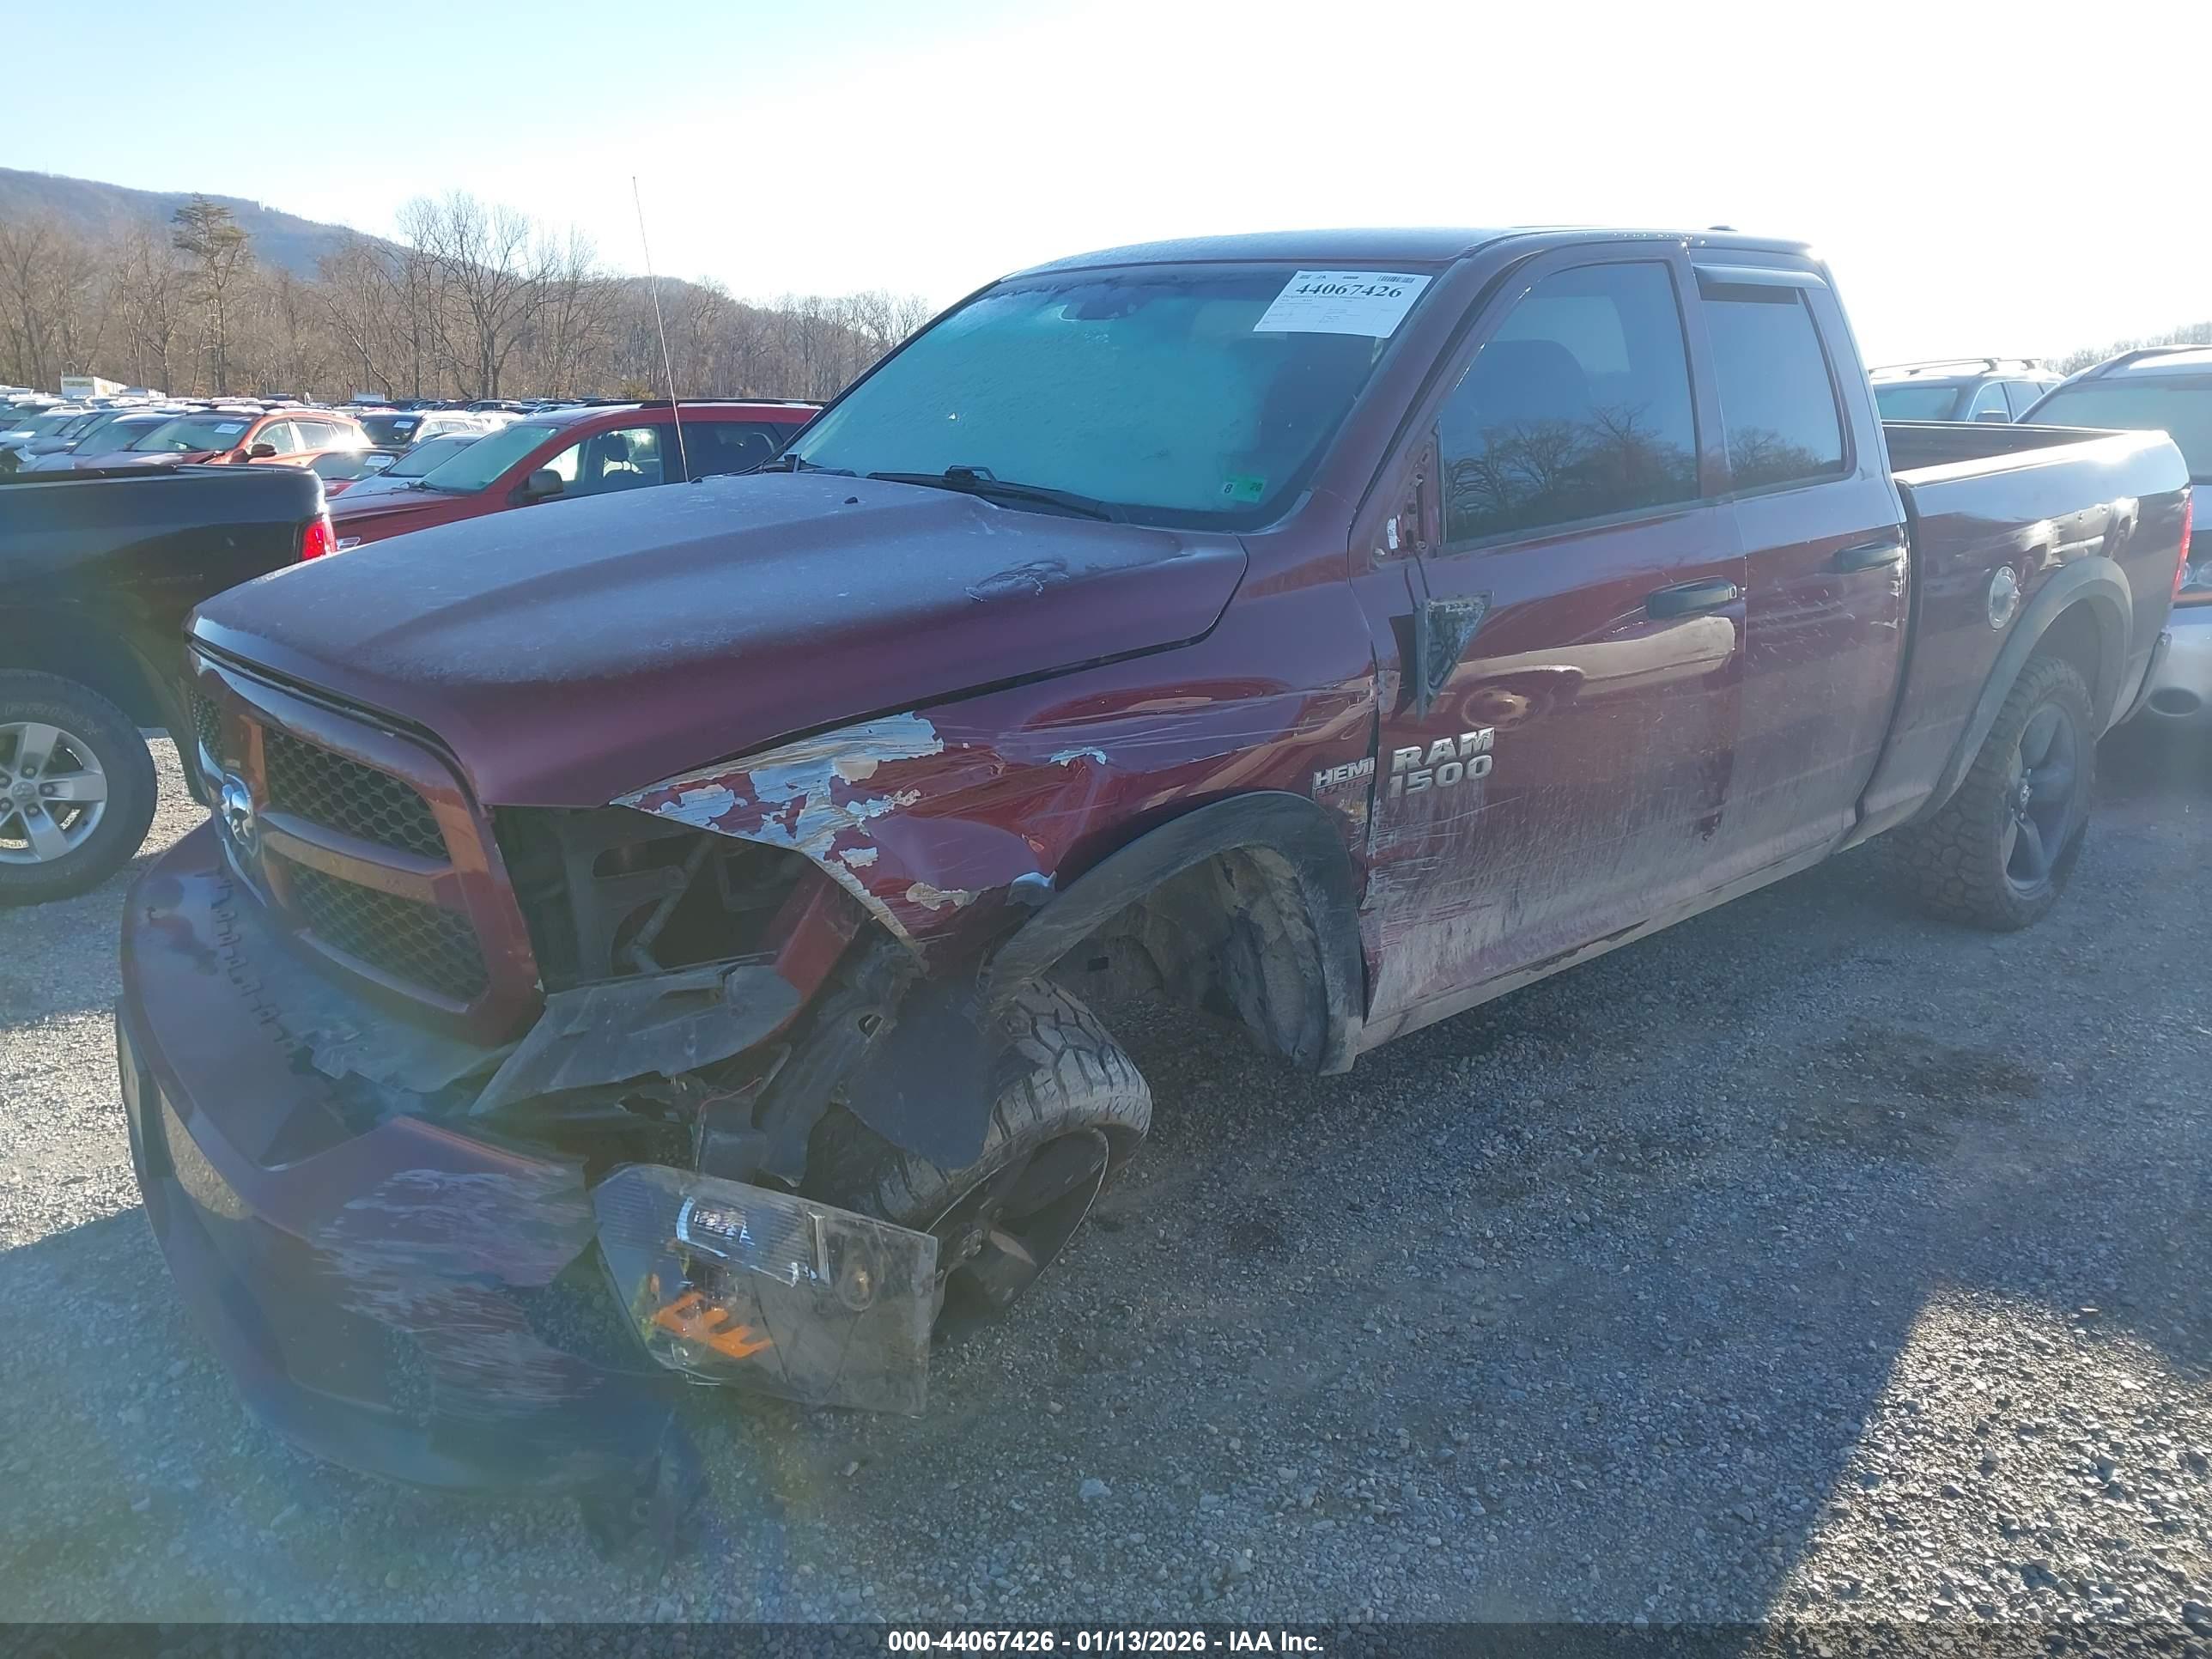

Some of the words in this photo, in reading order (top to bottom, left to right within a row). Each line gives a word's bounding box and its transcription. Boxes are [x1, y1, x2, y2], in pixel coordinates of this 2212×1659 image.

[1296, 283, 1405, 298] 44067426
[1391, 727, 1495, 772] RAM
[1314, 757, 1375, 787] HEMI
[1389, 755, 1493, 799] 1500
